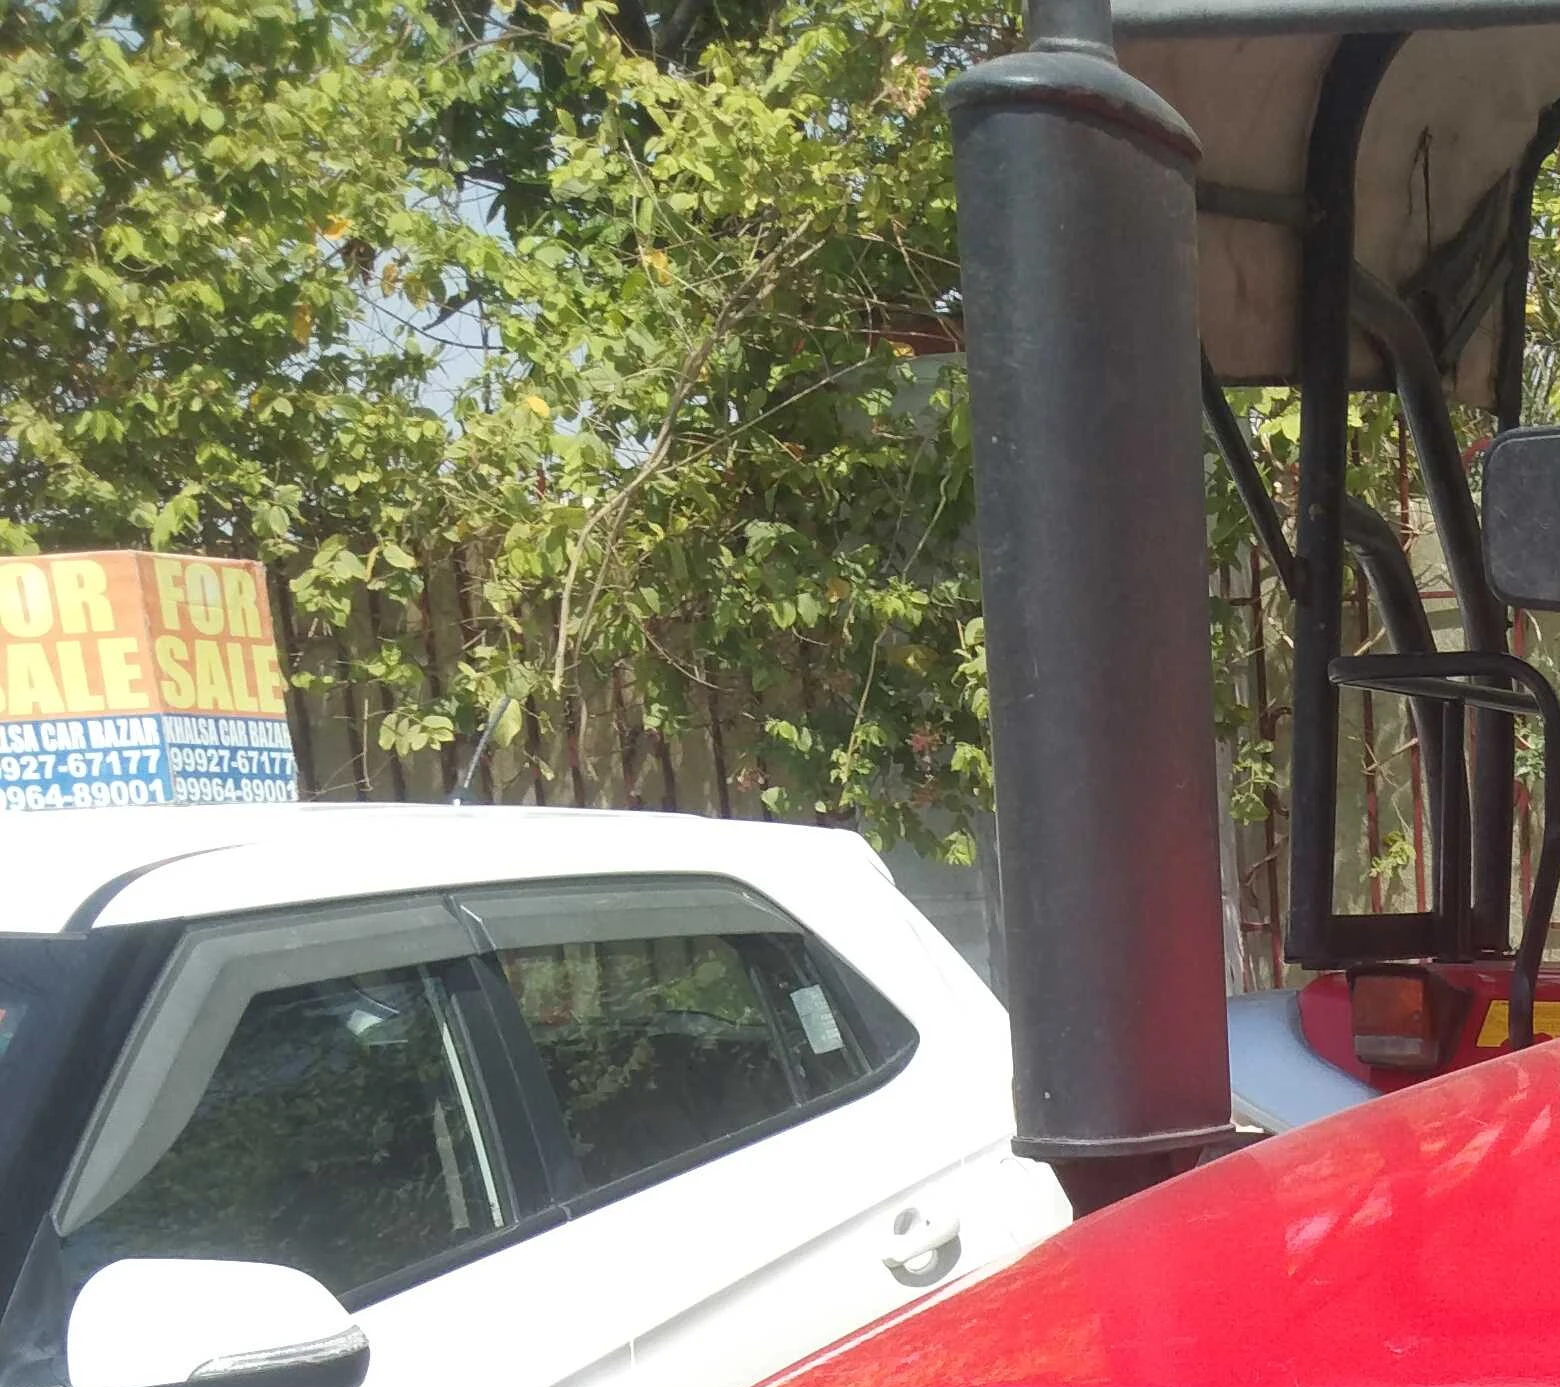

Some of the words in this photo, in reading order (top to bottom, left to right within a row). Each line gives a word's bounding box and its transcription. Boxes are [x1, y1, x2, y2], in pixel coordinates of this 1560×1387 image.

[153, 558, 262, 638] FOR
[0, 636, 150, 716] ALE
[155, 635, 286, 713] SALE
[40, 721, 87, 751] CAR
[87, 717, 160, 748] BAZAR
[161, 716, 220, 746] KHALSA
[218, 719, 249, 748] CAR
[247, 720, 293, 750] BAZAR
[0, 749, 160, 781] 927-67177
[170, 746, 295, 775] 99927-67177
[175, 777, 299, 802] 99964-89001
